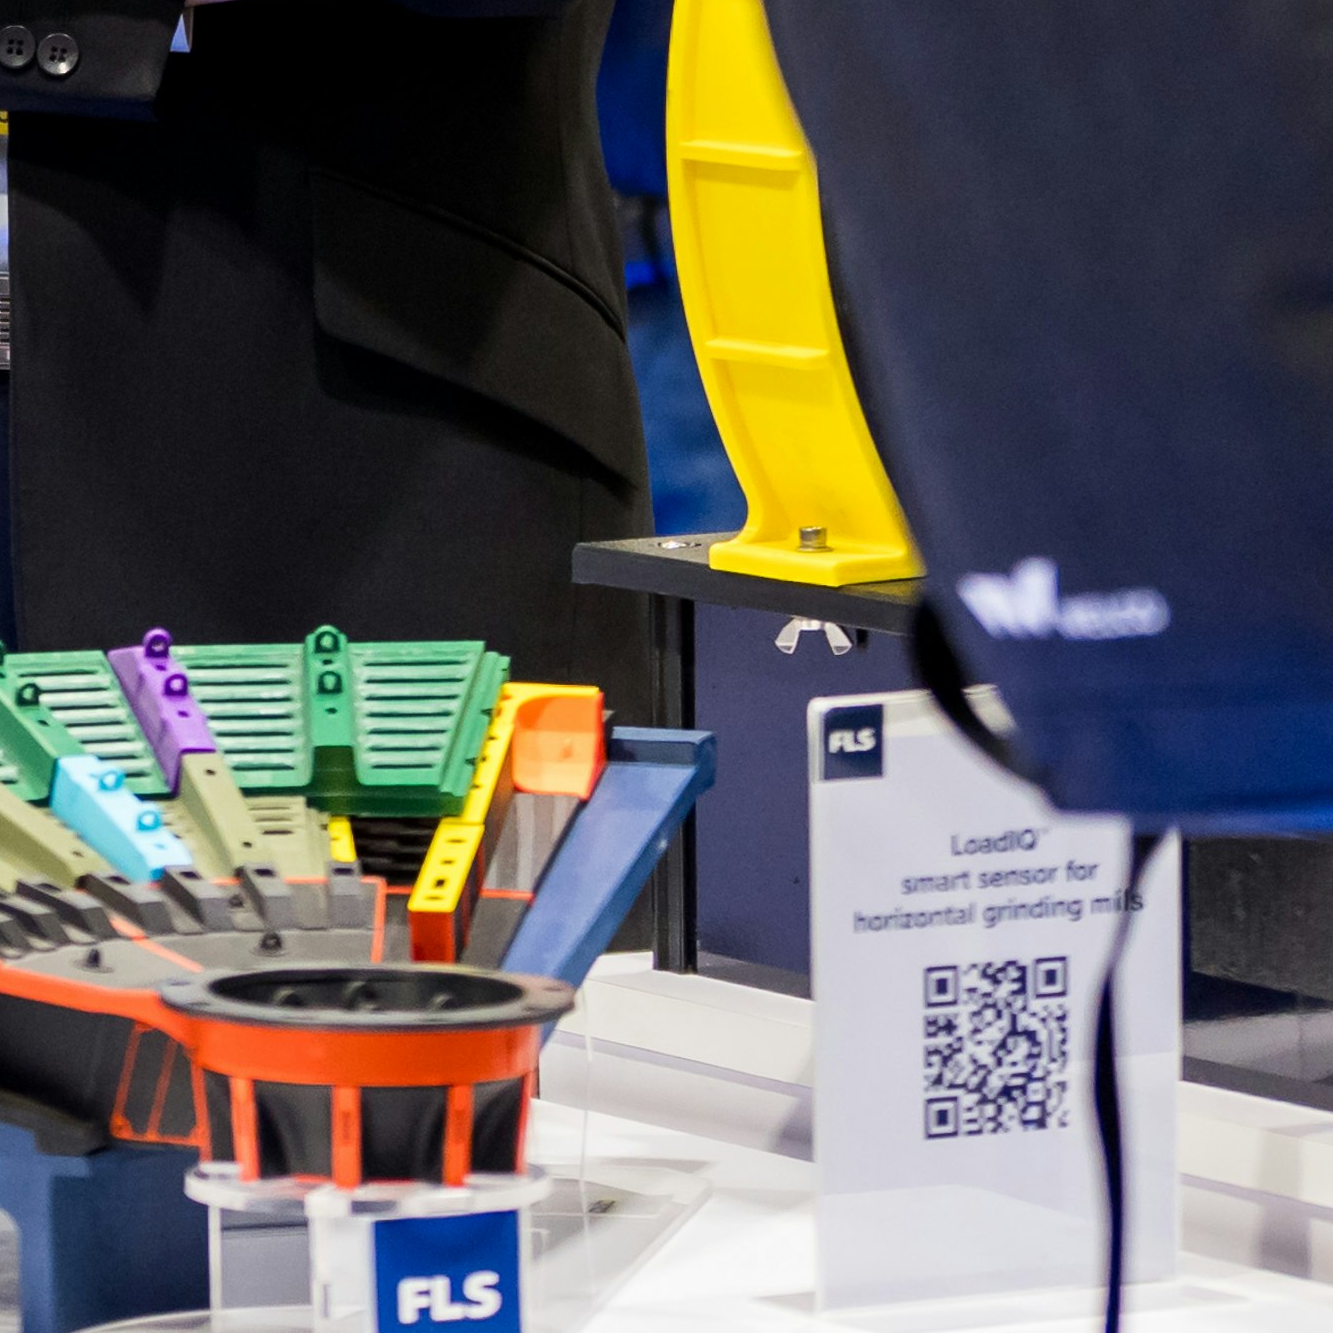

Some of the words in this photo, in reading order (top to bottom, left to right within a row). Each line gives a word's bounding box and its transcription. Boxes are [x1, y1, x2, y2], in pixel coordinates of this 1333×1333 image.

[828, 726, 876, 753] FLS
[901, 870, 970, 895] smart
[978, 865, 1059, 890] sensor
[1066, 859, 1100, 883] for
[852, 900, 978, 933] horizontal
[983, 895, 1083, 929] grinding
[397, 1270, 503, 1325] FLS
